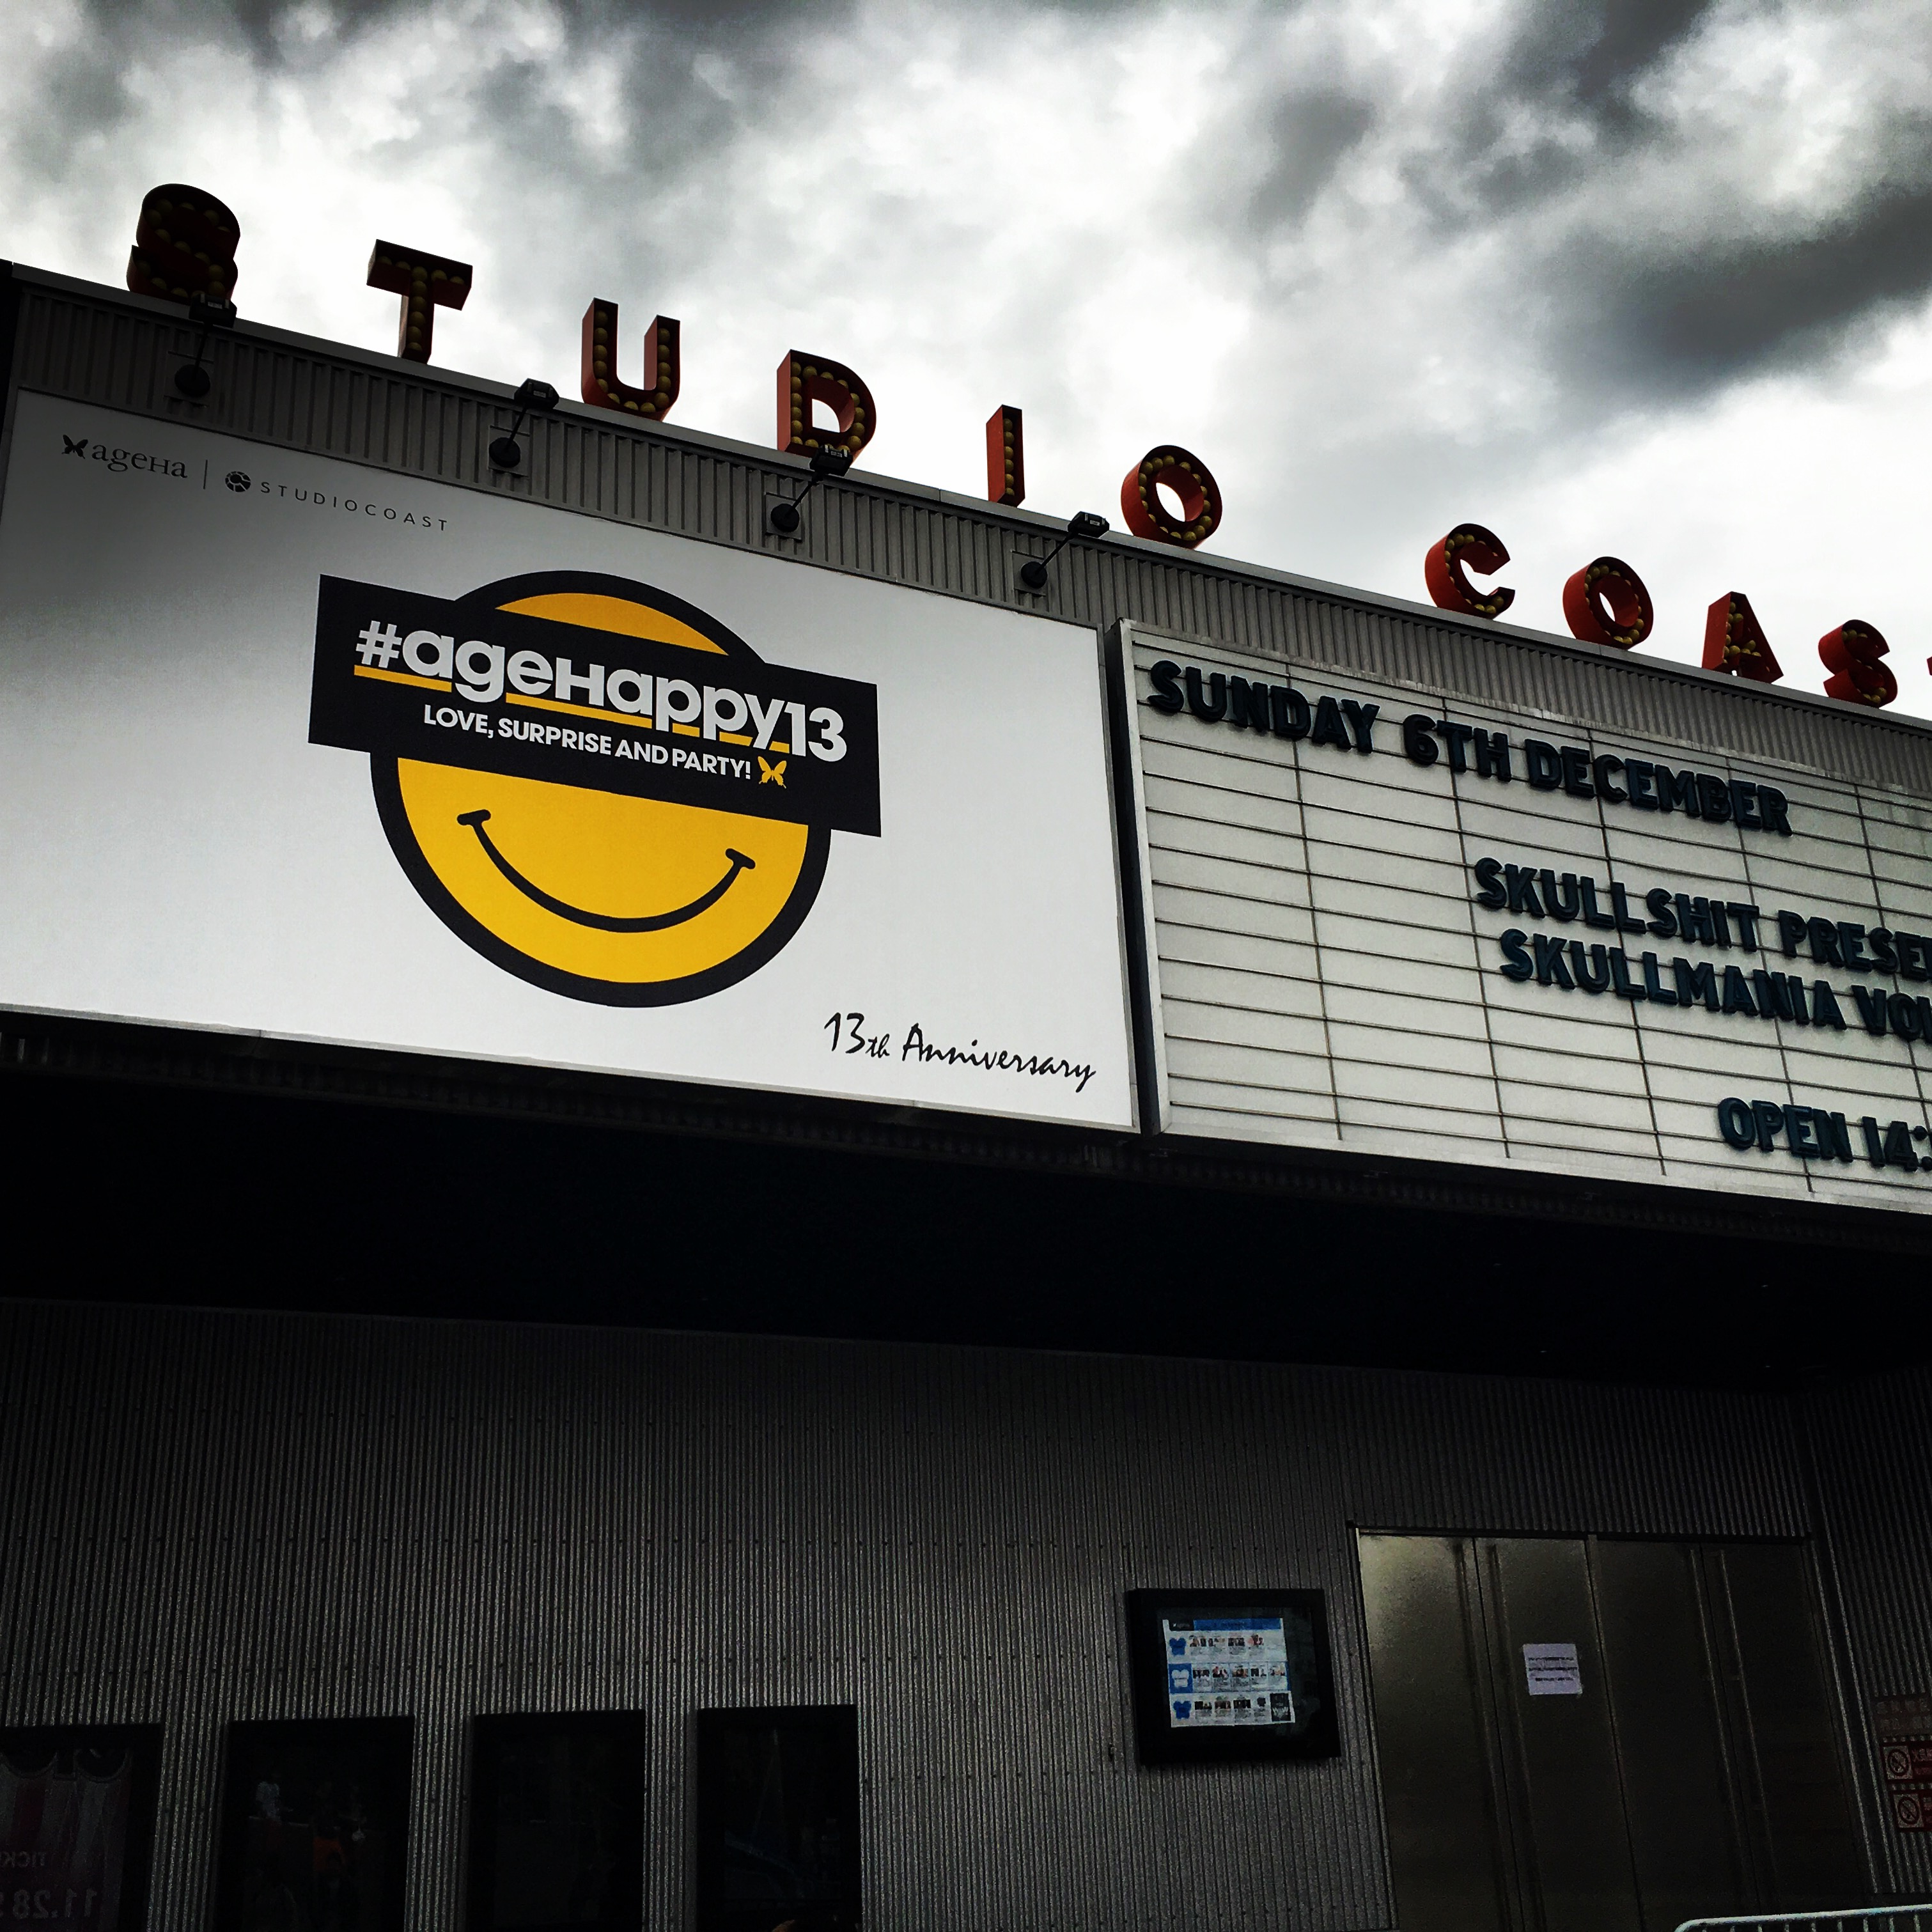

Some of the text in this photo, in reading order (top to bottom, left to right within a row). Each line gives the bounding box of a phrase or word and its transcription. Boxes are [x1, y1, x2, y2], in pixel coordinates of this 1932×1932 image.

[127, 183, 1932, 708] STUDIO COAS
[260, 480, 448, 531] STUDIOCOAST
[424, 704, 751, 780] LOVE, SURPRISE AND PARTY!
[1147, 660, 1793, 836] SUNDAY 6TH DECEMBER
[1474, 857, 1759, 953] SKULLSHIT
[1500, 928, 1847, 1030] SKULLMANIA
[824, 1012, 1097, 1093] 13th Anniversary
[1718, 1097, 1932, 1172] OPEN 14:
